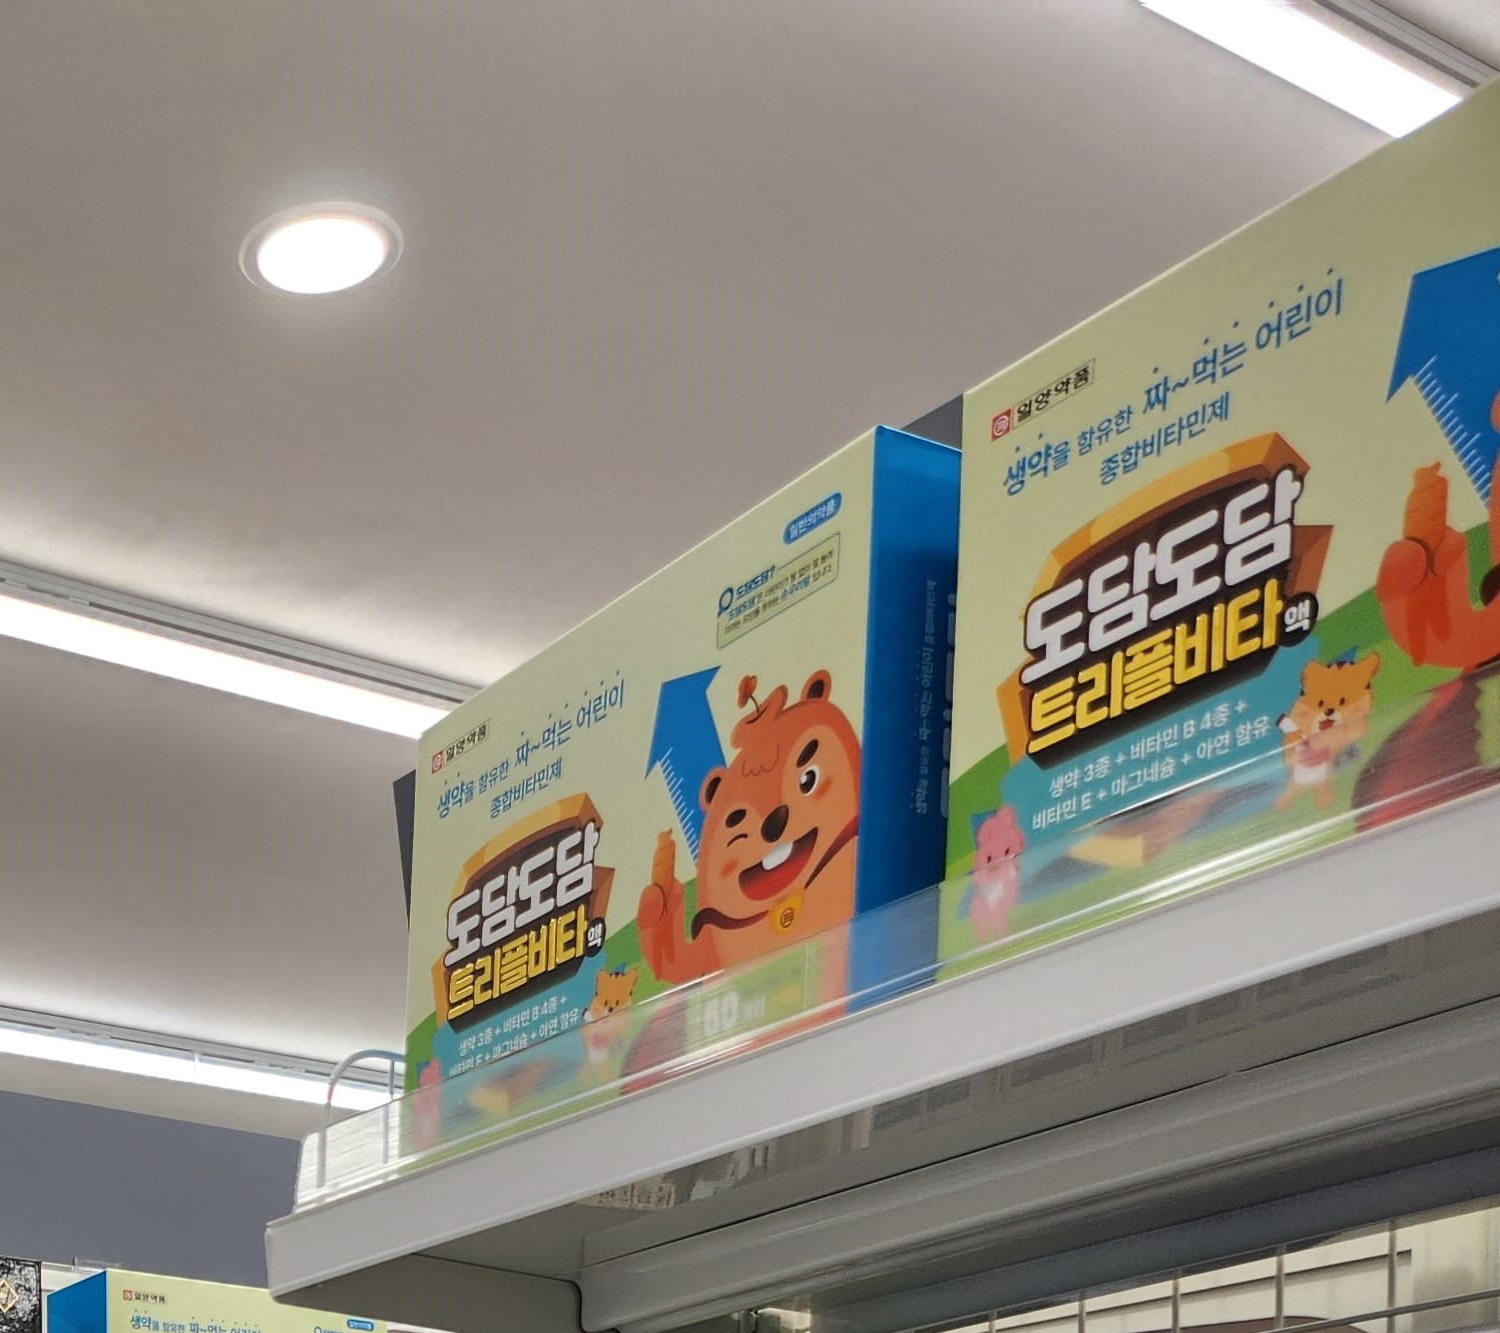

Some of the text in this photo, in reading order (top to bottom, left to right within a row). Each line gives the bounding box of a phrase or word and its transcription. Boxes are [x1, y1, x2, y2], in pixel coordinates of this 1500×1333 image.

[1003, 276, 1344, 497] 생약을 함유한 짜~먹는 어린이
[1016, 368, 1092, 424] 일양약품
[1099, 392, 1230, 486] 종합비타민제
[1021, 467, 1302, 684] 도담도담
[1028, 577, 1284, 754] 트리플비타
[1284, 600, 1311, 632] 액
[437, 678, 626, 820] 생약을 함유한 짜~먹는 어린이
[490, 758, 563, 820] 종합비타민제
[1111, 715, 1271, 797] 마그네슘 아연 함유
[445, 819, 602, 967] 도담도담
[448, 903, 589, 1021] 트리플비타
[129, 1313, 160, 1333] 생약을
